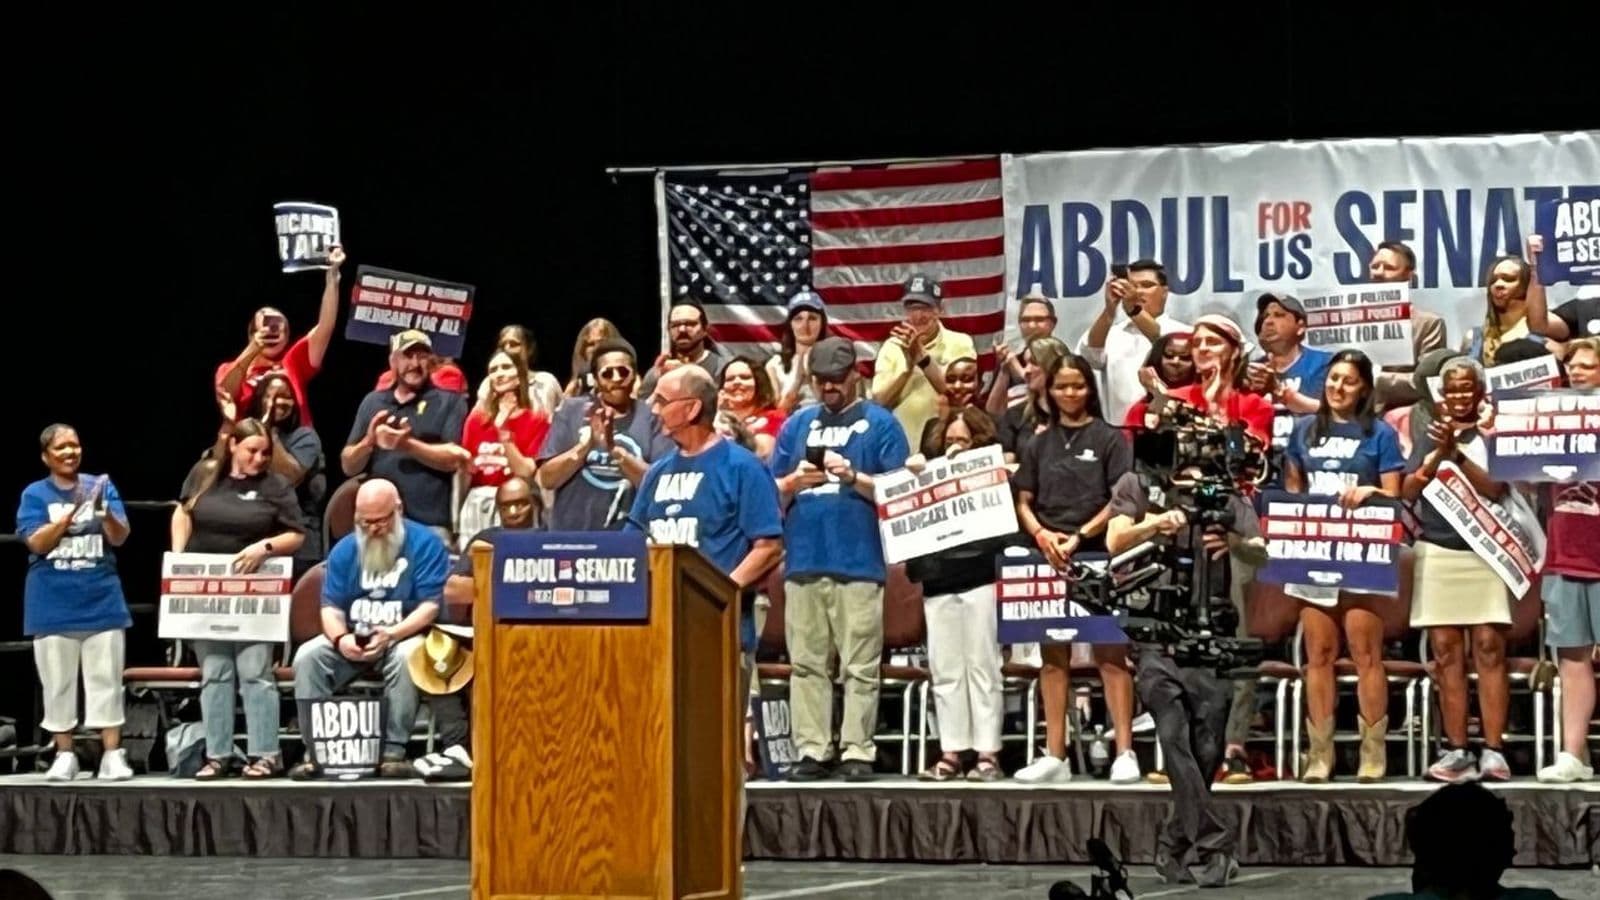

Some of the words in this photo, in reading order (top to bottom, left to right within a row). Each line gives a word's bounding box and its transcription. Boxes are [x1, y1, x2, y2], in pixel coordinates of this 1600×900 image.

[1258, 201, 1312, 239] FOR
[1016, 195, 1244, 299] ABDUL
[1259, 233, 1312, 281] US
[439, 318, 460, 336] ALL
[1356, 325, 1379, 342] FOR
[1383, 322, 1404, 340] ALL
[1570, 433, 1597, 454] FOR
[952, 495, 976, 517] FOR
[981, 489, 1003, 510] ALL
[1335, 541, 1364, 564] FOR
[1366, 542, 1392, 564] ALL
[503, 558, 557, 583] ABDUL
[575, 558, 636, 583] SENATE
[234, 597, 259, 614] FOR
[261, 597, 281, 614] ALL
[1002, 599, 1066, 620] MEDICARE
